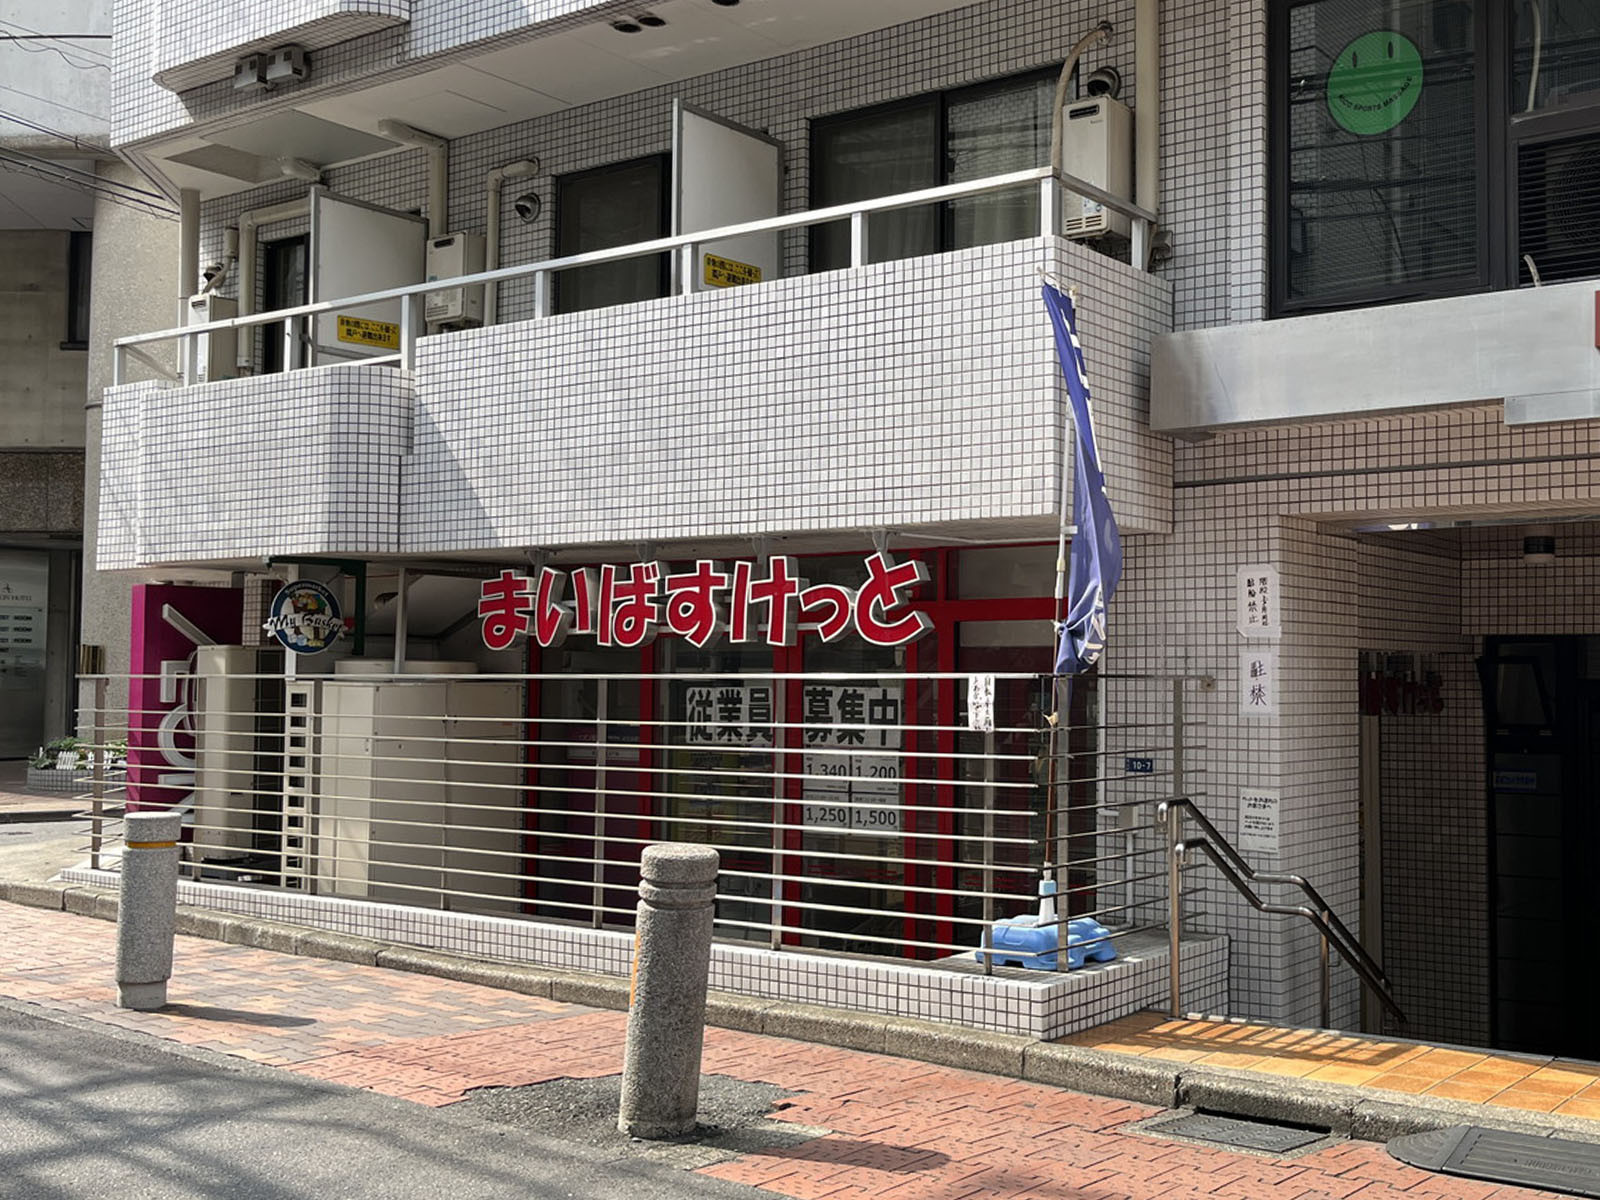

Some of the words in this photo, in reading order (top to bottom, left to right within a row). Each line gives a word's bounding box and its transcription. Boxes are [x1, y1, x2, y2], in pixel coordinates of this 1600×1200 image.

[478, 552, 926, 650] まいばすけっと
[688, 688, 773, 742] 従業員
[805, 687, 899, 746] 募集中
[855, 766, 897, 780] 1200
[806, 807, 847, 824] 1,250
[855, 810, 897, 827] 1,500
